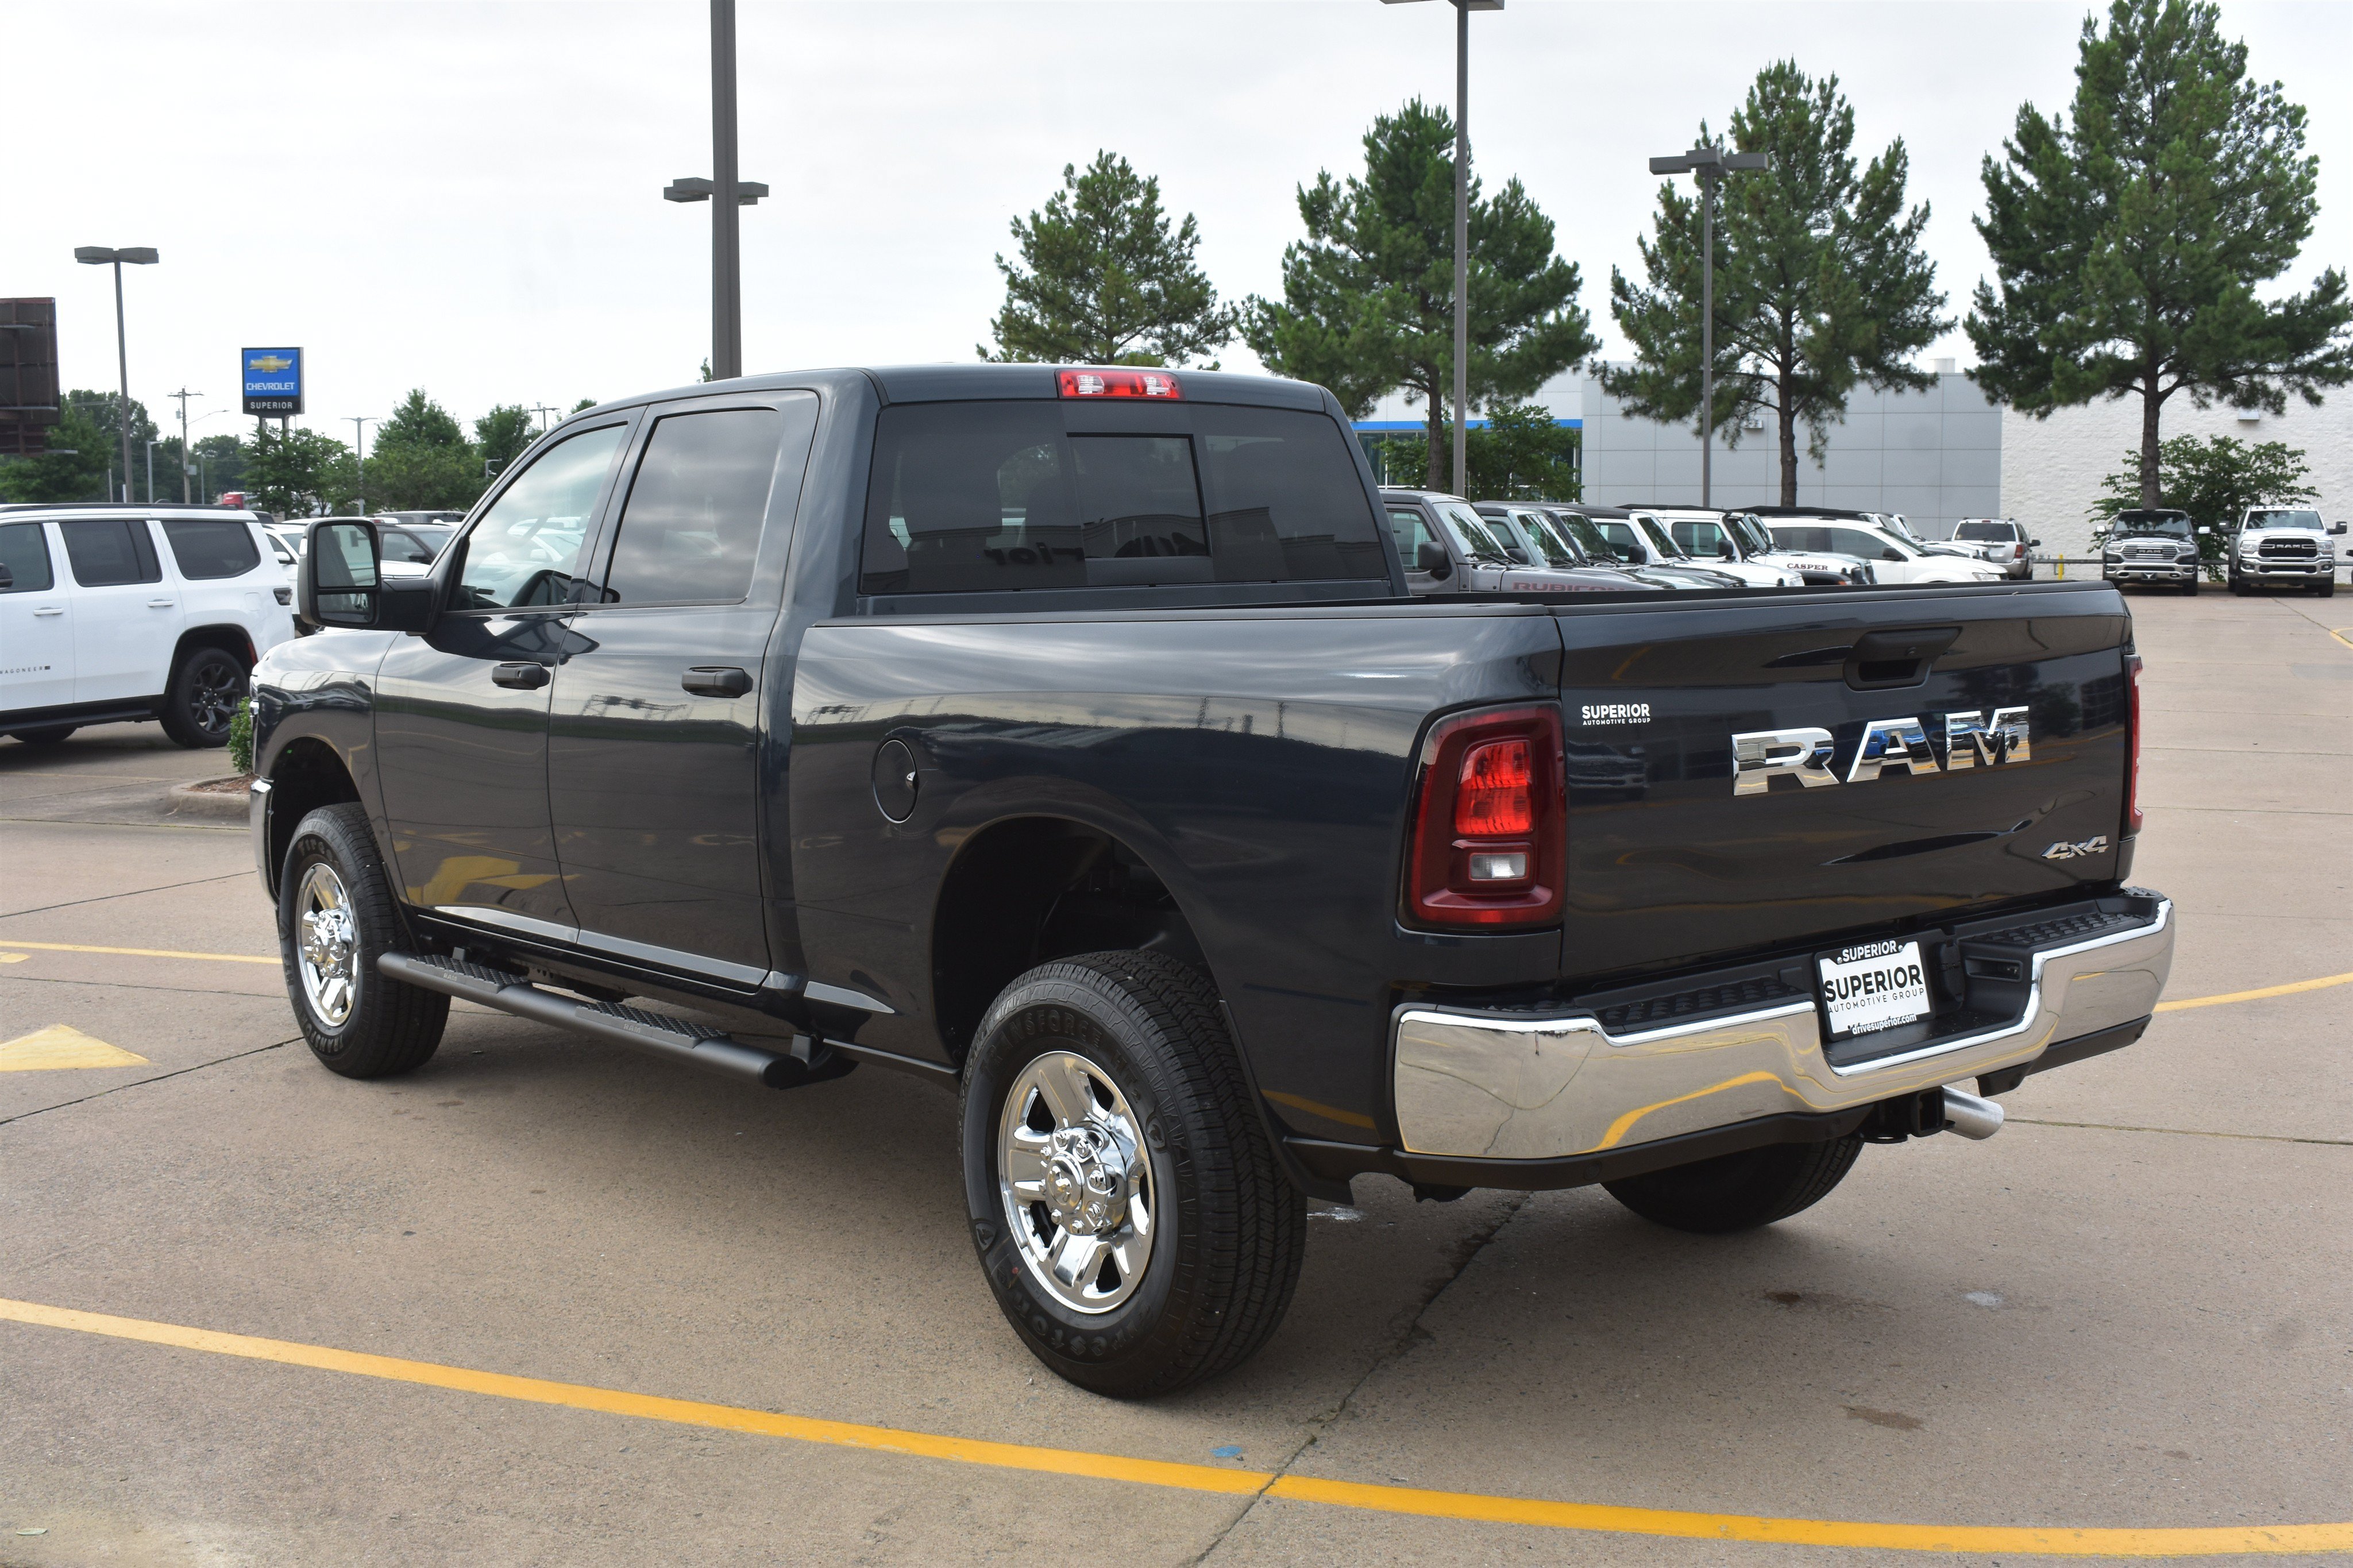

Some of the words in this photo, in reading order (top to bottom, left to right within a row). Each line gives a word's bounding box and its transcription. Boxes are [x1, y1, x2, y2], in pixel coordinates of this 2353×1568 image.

[246, 382, 295, 391] CHEVROLET
[1581, 704, 1650, 719] SUPERIOR
[1731, 705, 2031, 796] RAM
[1842, 940, 1897, 962] SUPERIOR
[1823, 964, 1923, 1002] SUPERIOR
[1829, 995, 1887, 1013] AUTOMOTIVE
[1893, 988, 1924, 1001] GROUP
[1851, 1013, 1918, 1035] drivesuperior.com
